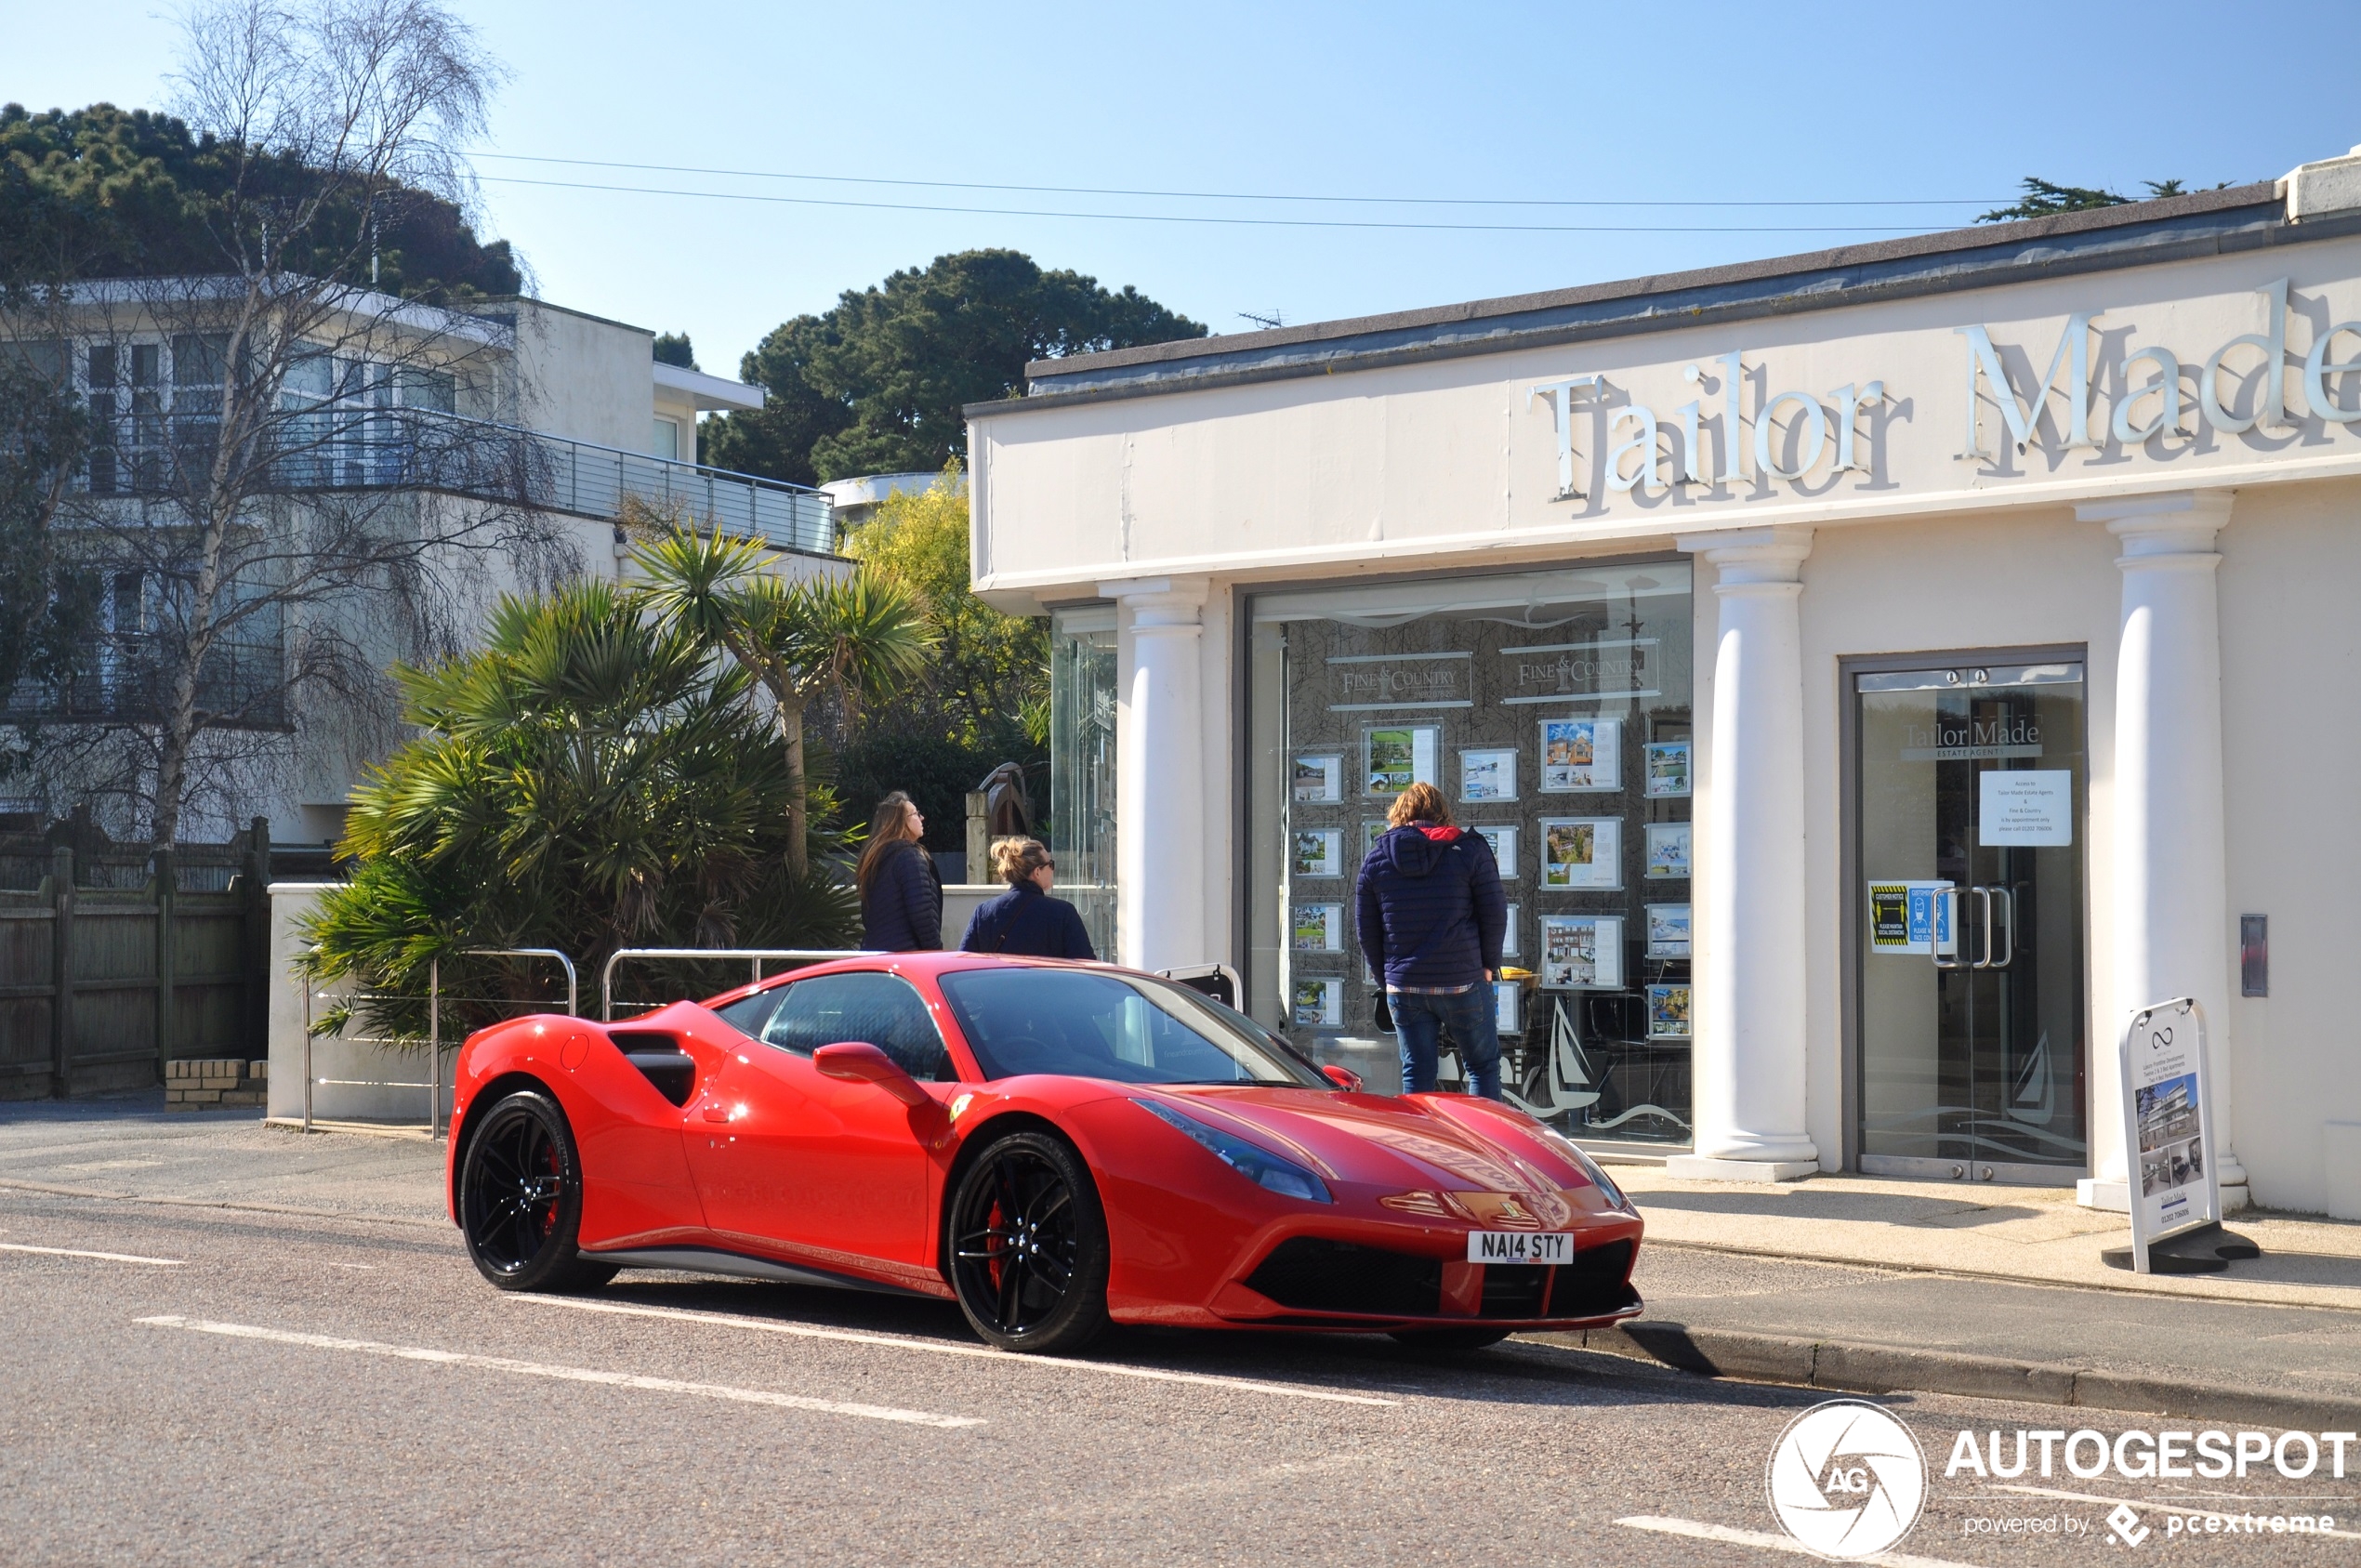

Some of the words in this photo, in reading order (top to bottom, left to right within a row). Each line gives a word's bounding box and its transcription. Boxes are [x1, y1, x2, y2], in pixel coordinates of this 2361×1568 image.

[1525, 349, 1884, 504] Tailor
[1953, 277, 2361, 460] Made
[1342, 673, 1378, 694] FINE
[1379, 665, 1391, 678] &
[1392, 670, 1457, 692] COUNTRY
[1519, 664, 1555, 686] FINE
[1558, 655, 1570, 668] &
[1571, 659, 1642, 681] COUNTRY
[1904, 723, 1968, 746] Tailor
[1973, 719, 2039, 744] Made
[2161, 1213, 2174, 1224] 01202
[1482, 1233, 1525, 1258] NA14
[1532, 1234, 1564, 1258] STY
